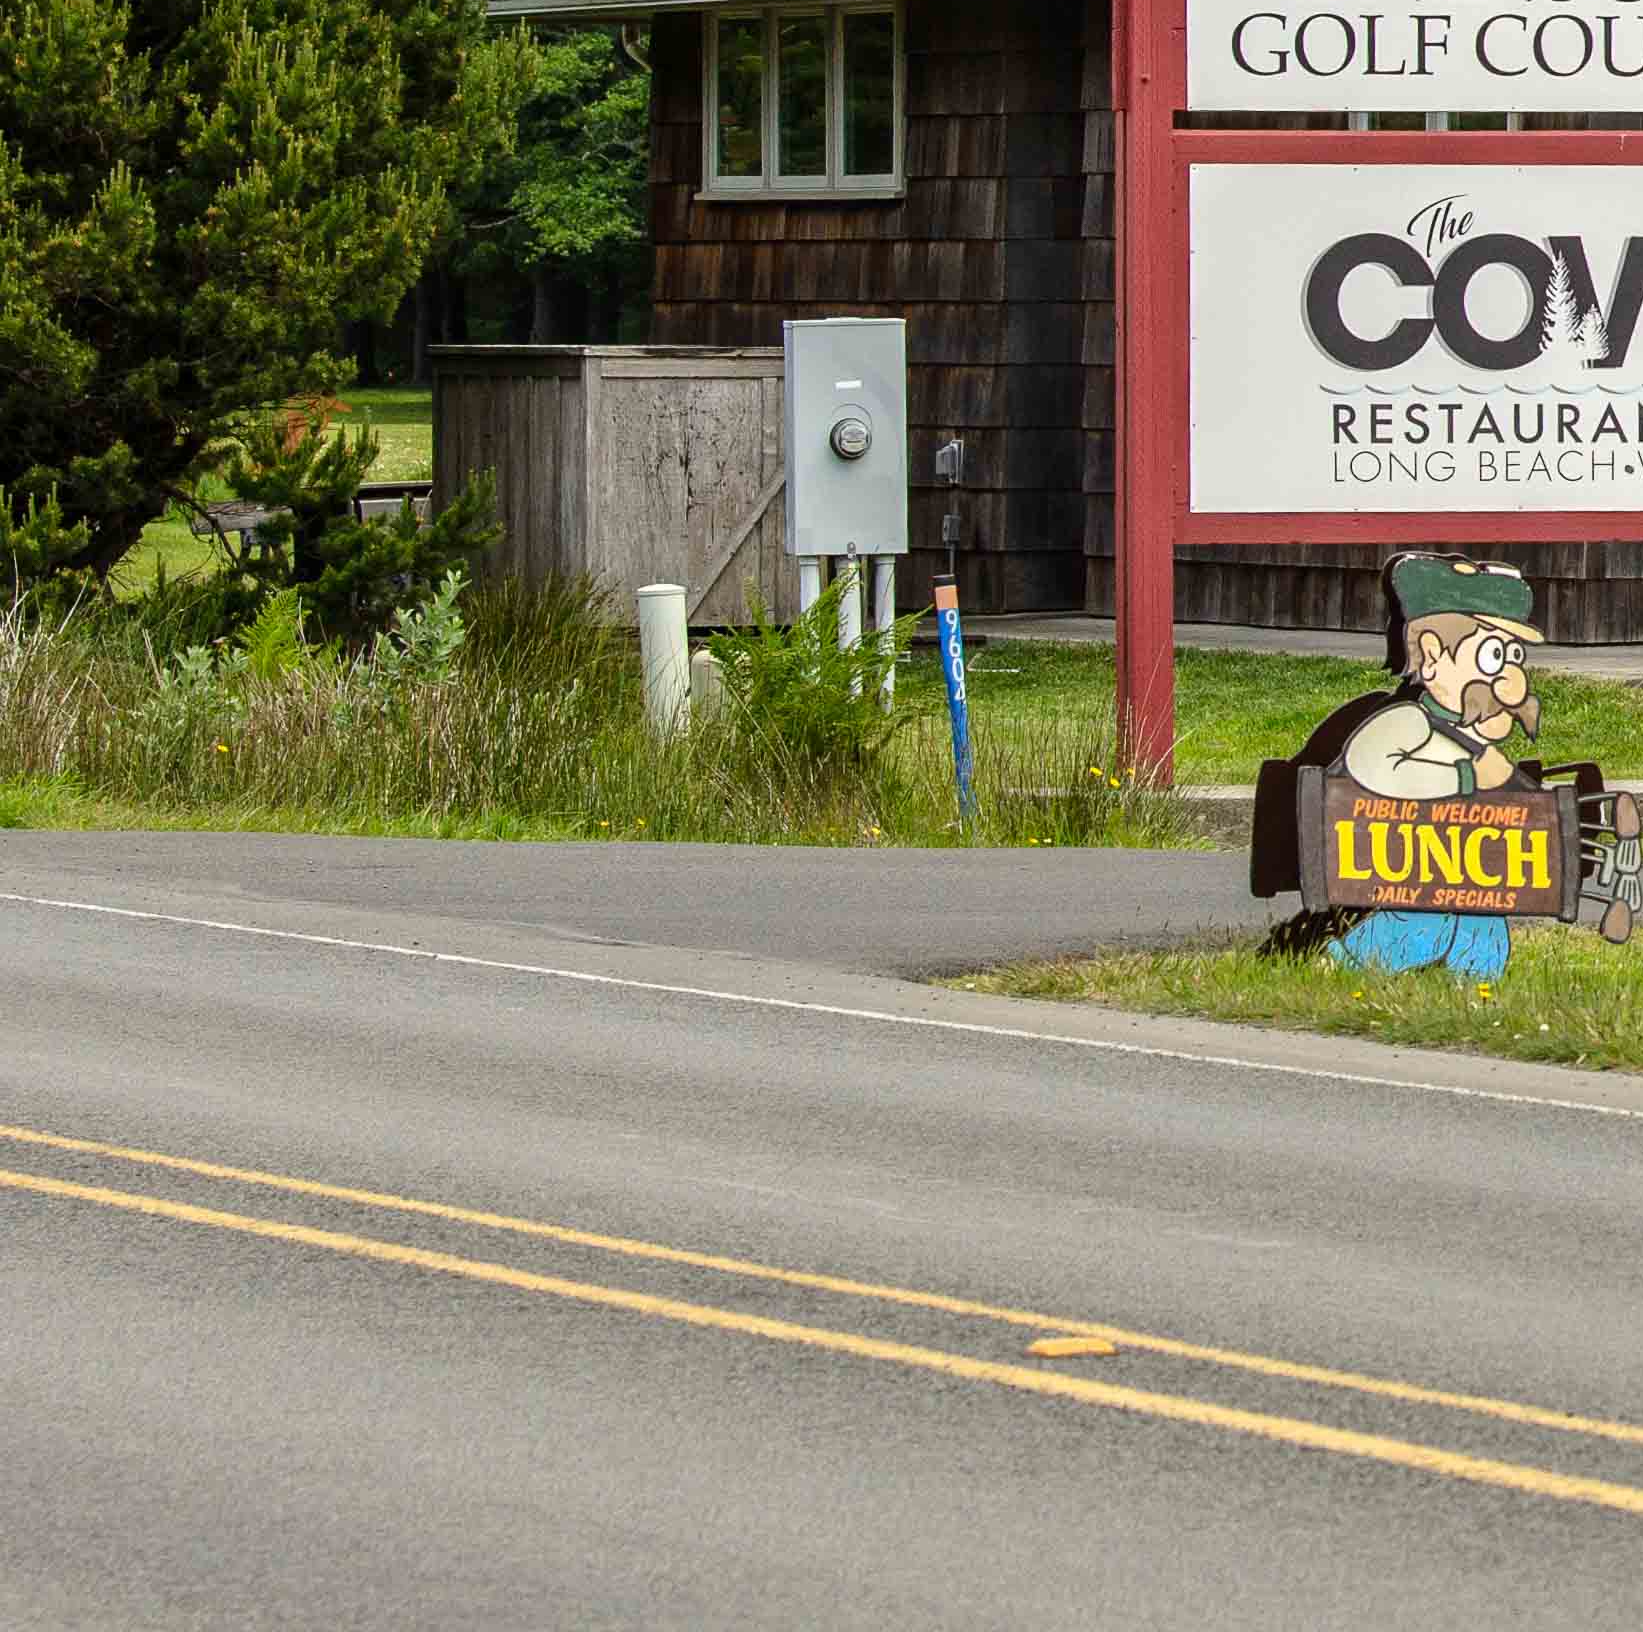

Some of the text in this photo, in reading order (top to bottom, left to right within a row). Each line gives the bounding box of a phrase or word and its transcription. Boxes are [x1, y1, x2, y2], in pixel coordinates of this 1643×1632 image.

[1231, 12, 1451, 77] GOLF
[1406, 194, 1474, 258] The
[1333, 450, 1457, 483] LONG
[946, 609, 967, 704] 9604
[1353, 799, 1528, 827] PUBLIC WELCOME!
[1334, 820, 1552, 889] LUNCH
[1432, 887, 1517, 909] SPECIALS
